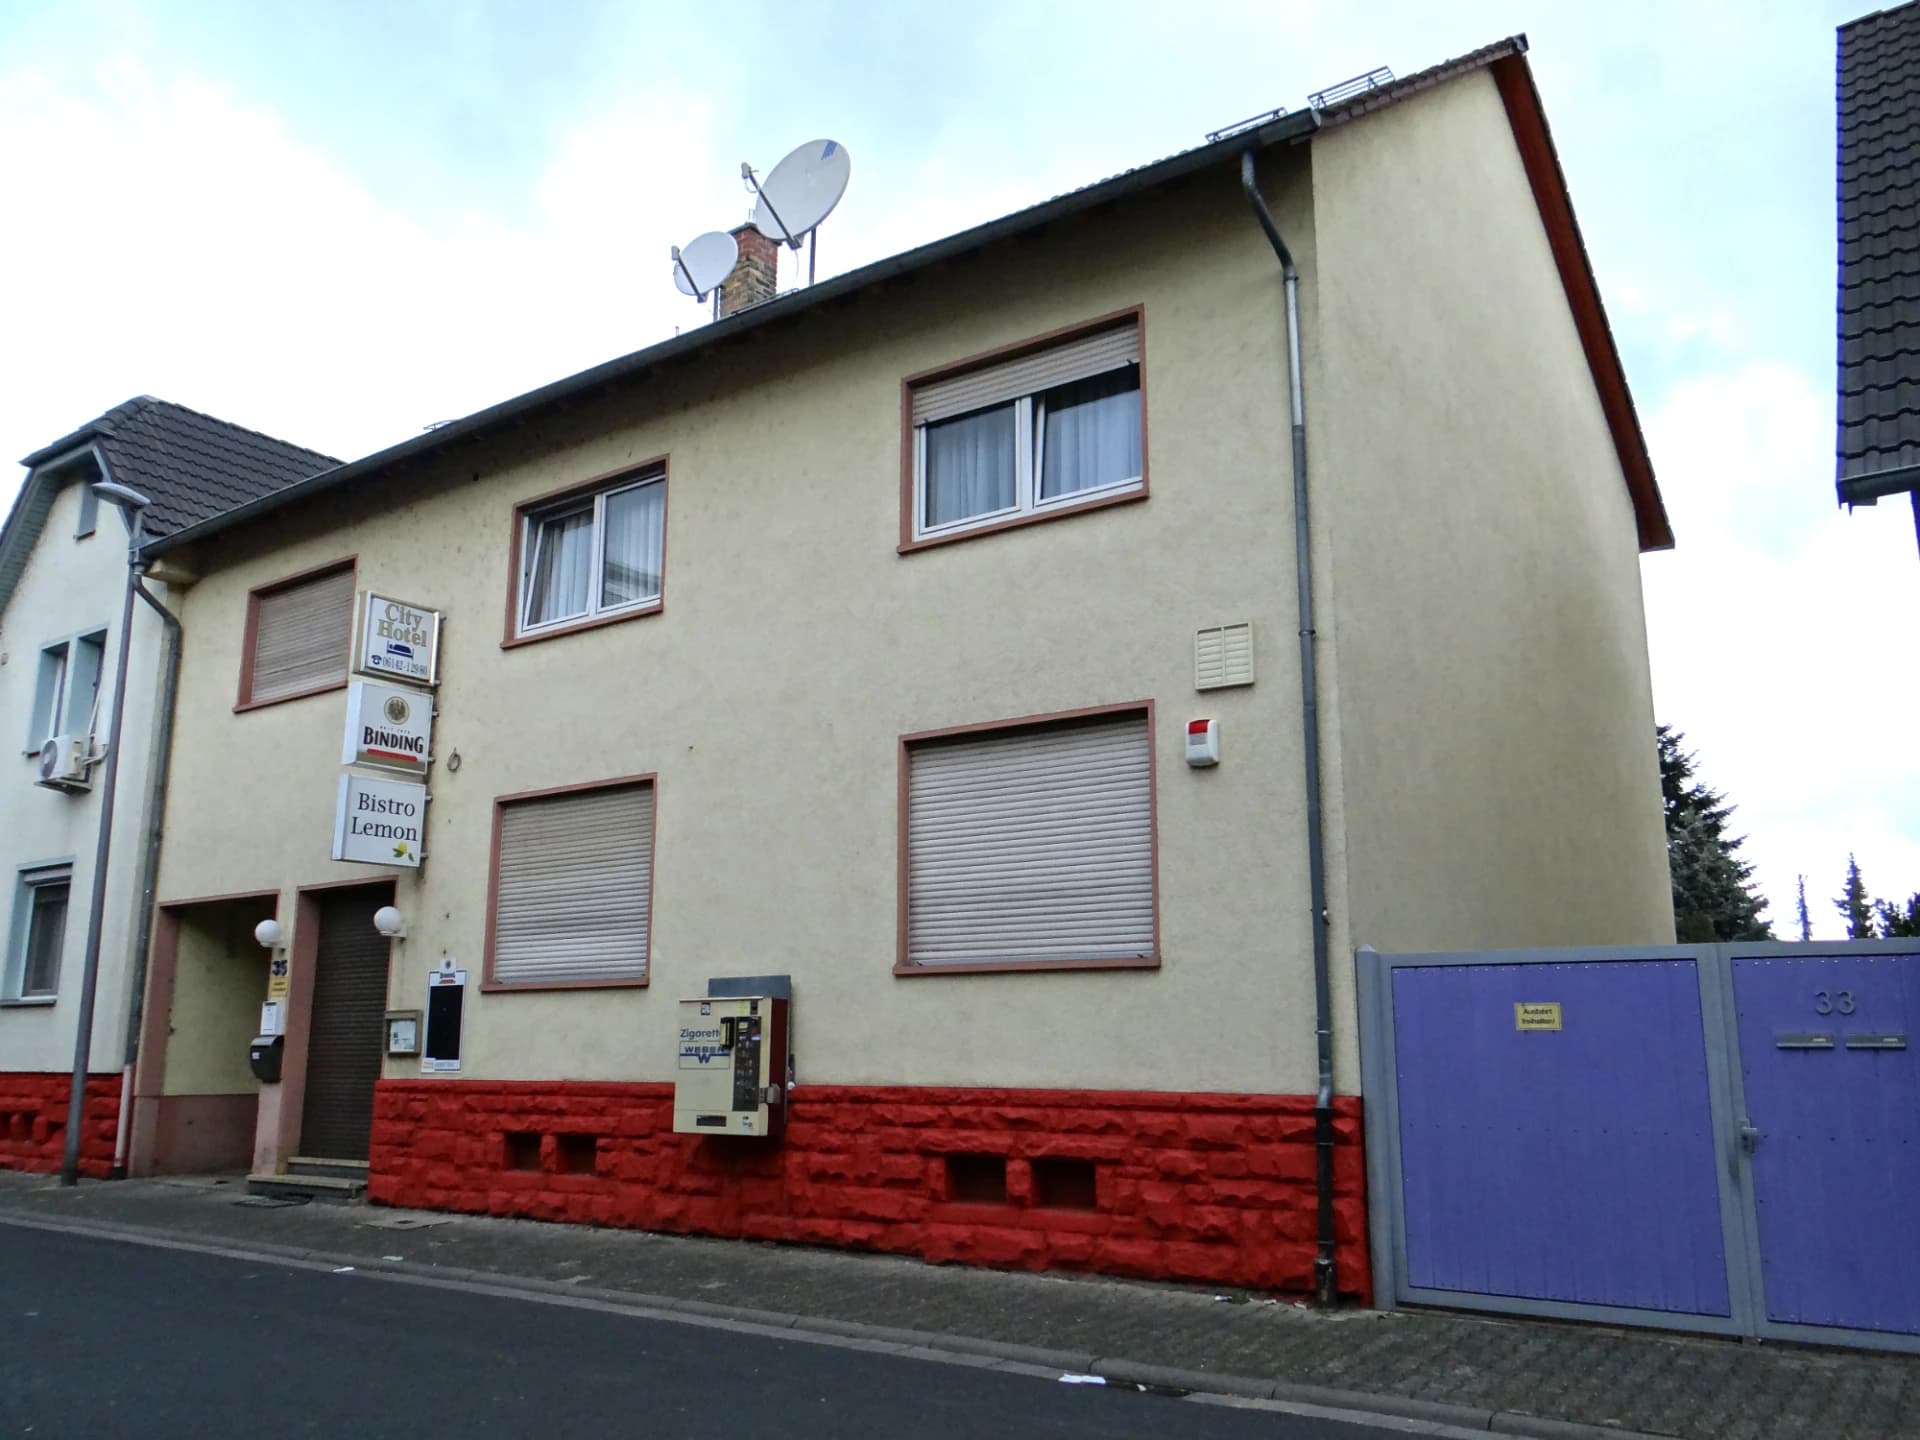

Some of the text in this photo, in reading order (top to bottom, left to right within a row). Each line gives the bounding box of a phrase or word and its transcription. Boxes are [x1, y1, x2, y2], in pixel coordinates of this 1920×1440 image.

[384, 603, 423, 632] City
[376, 618, 428, 648] Hotel
[363, 726, 425, 754] BINDING
[357, 792, 416, 817] Bistro
[351, 816, 419, 842] Lemon
[272, 960, 288, 976] 35
[1815, 991, 1856, 1015] 33
